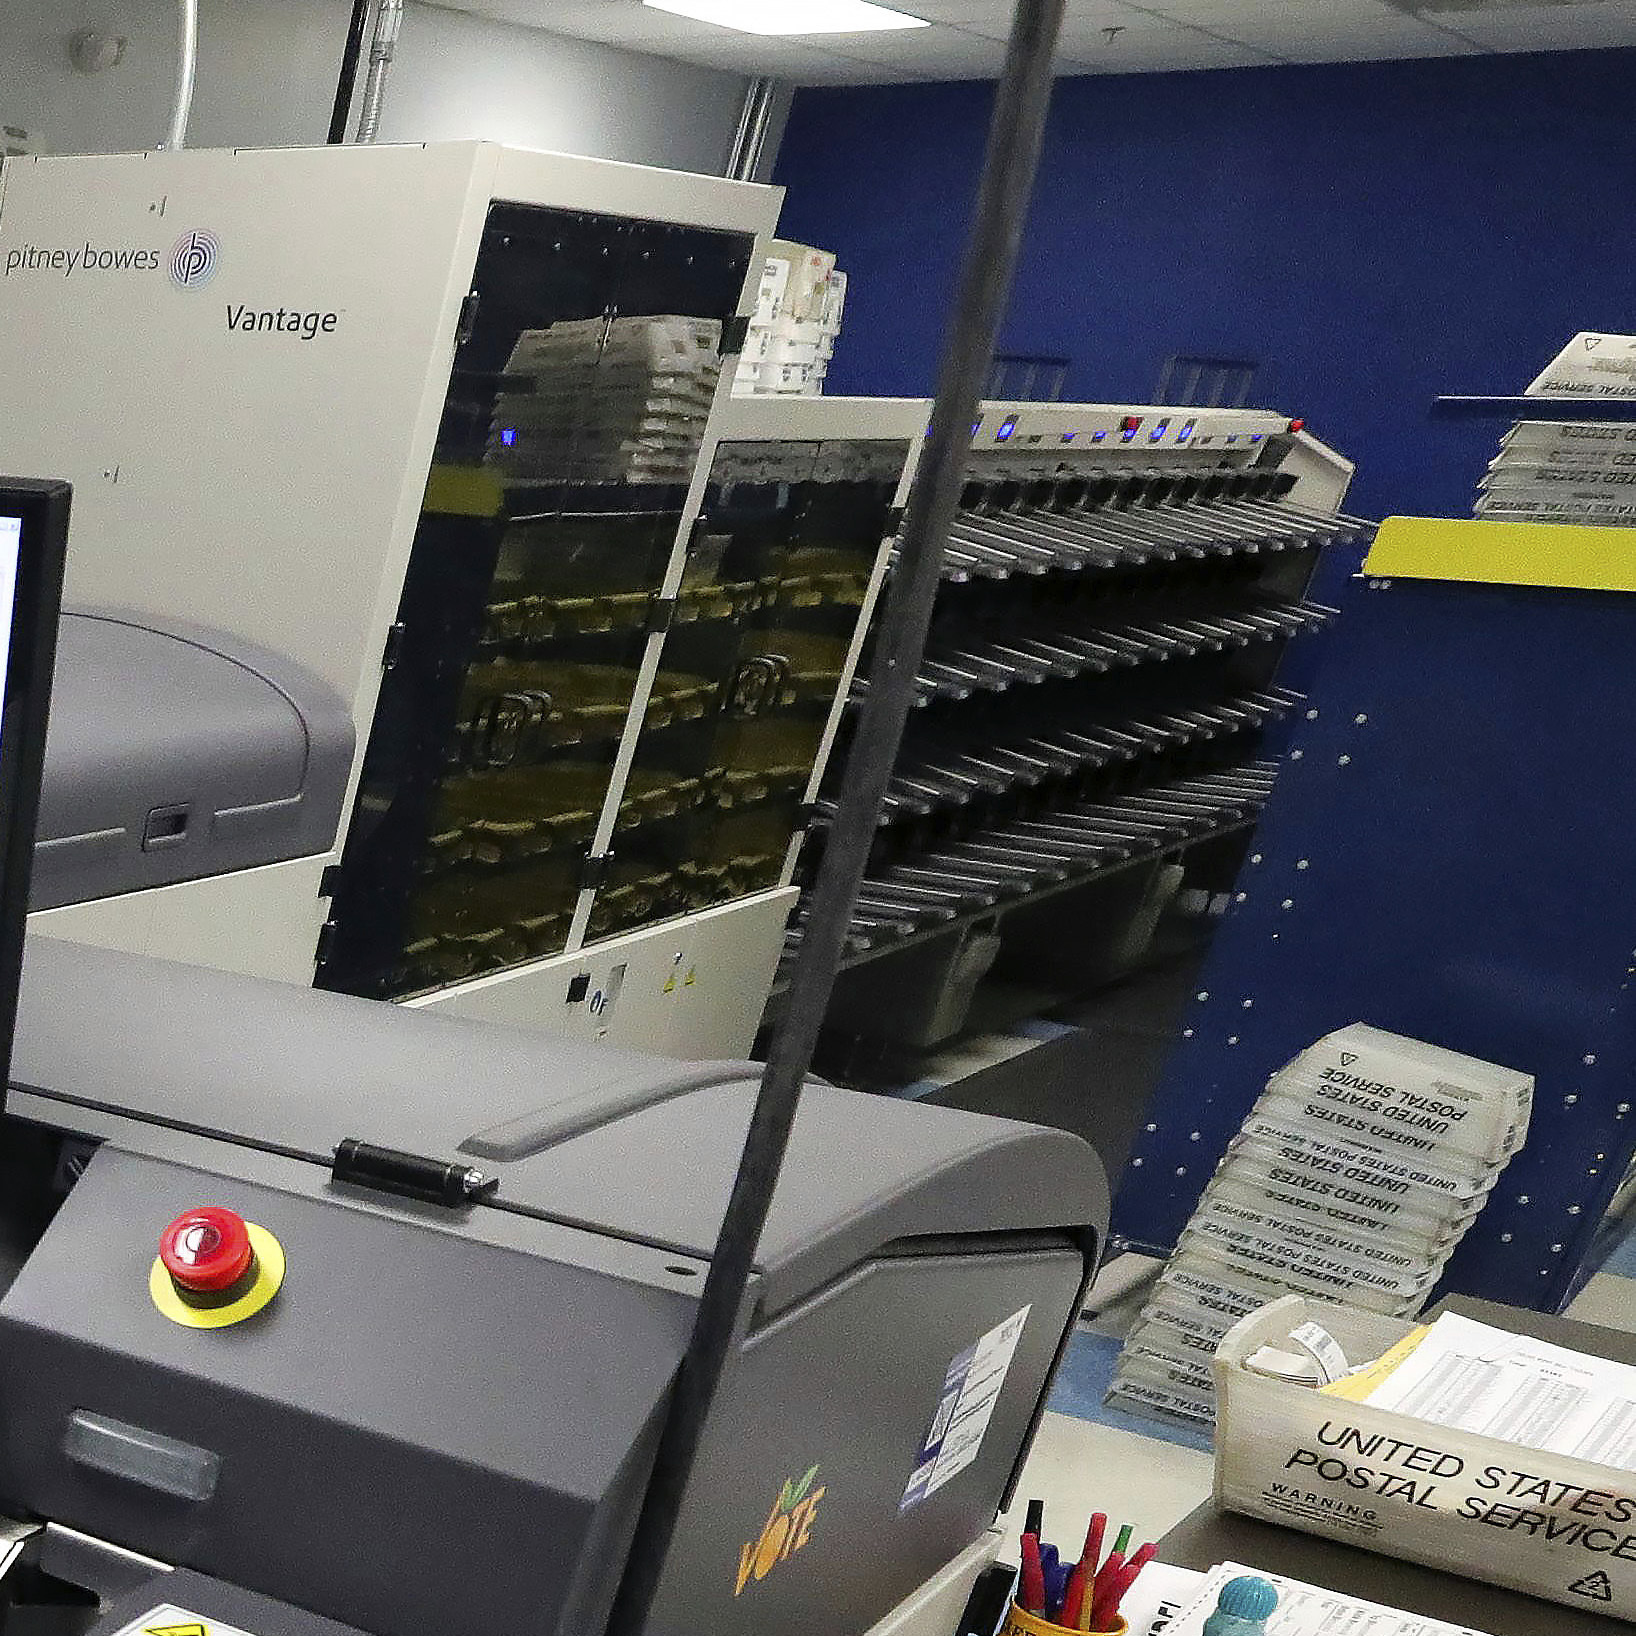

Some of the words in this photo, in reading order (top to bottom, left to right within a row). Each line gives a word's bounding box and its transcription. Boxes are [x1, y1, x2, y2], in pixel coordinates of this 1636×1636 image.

[6, 243, 78, 277] pitney
[83, 241, 160, 270] bowes
[226, 304, 339, 340] Vantage
[1318, 1086, 1382, 1111] STATES
[1320, 1068, 1394, 1097] SERVICE
[1383, 1106, 1448, 1132] UNITED
[1400, 1093, 1466, 1119] POSTAL
[1318, 1421, 1464, 1479] UNITED
[1475, 1466, 1636, 1523] STATES
[1271, 1482, 1379, 1521] WARNING
[1285, 1448, 1440, 1510] POSTAL
[1456, 1497, 1636, 1561] SERVICE
